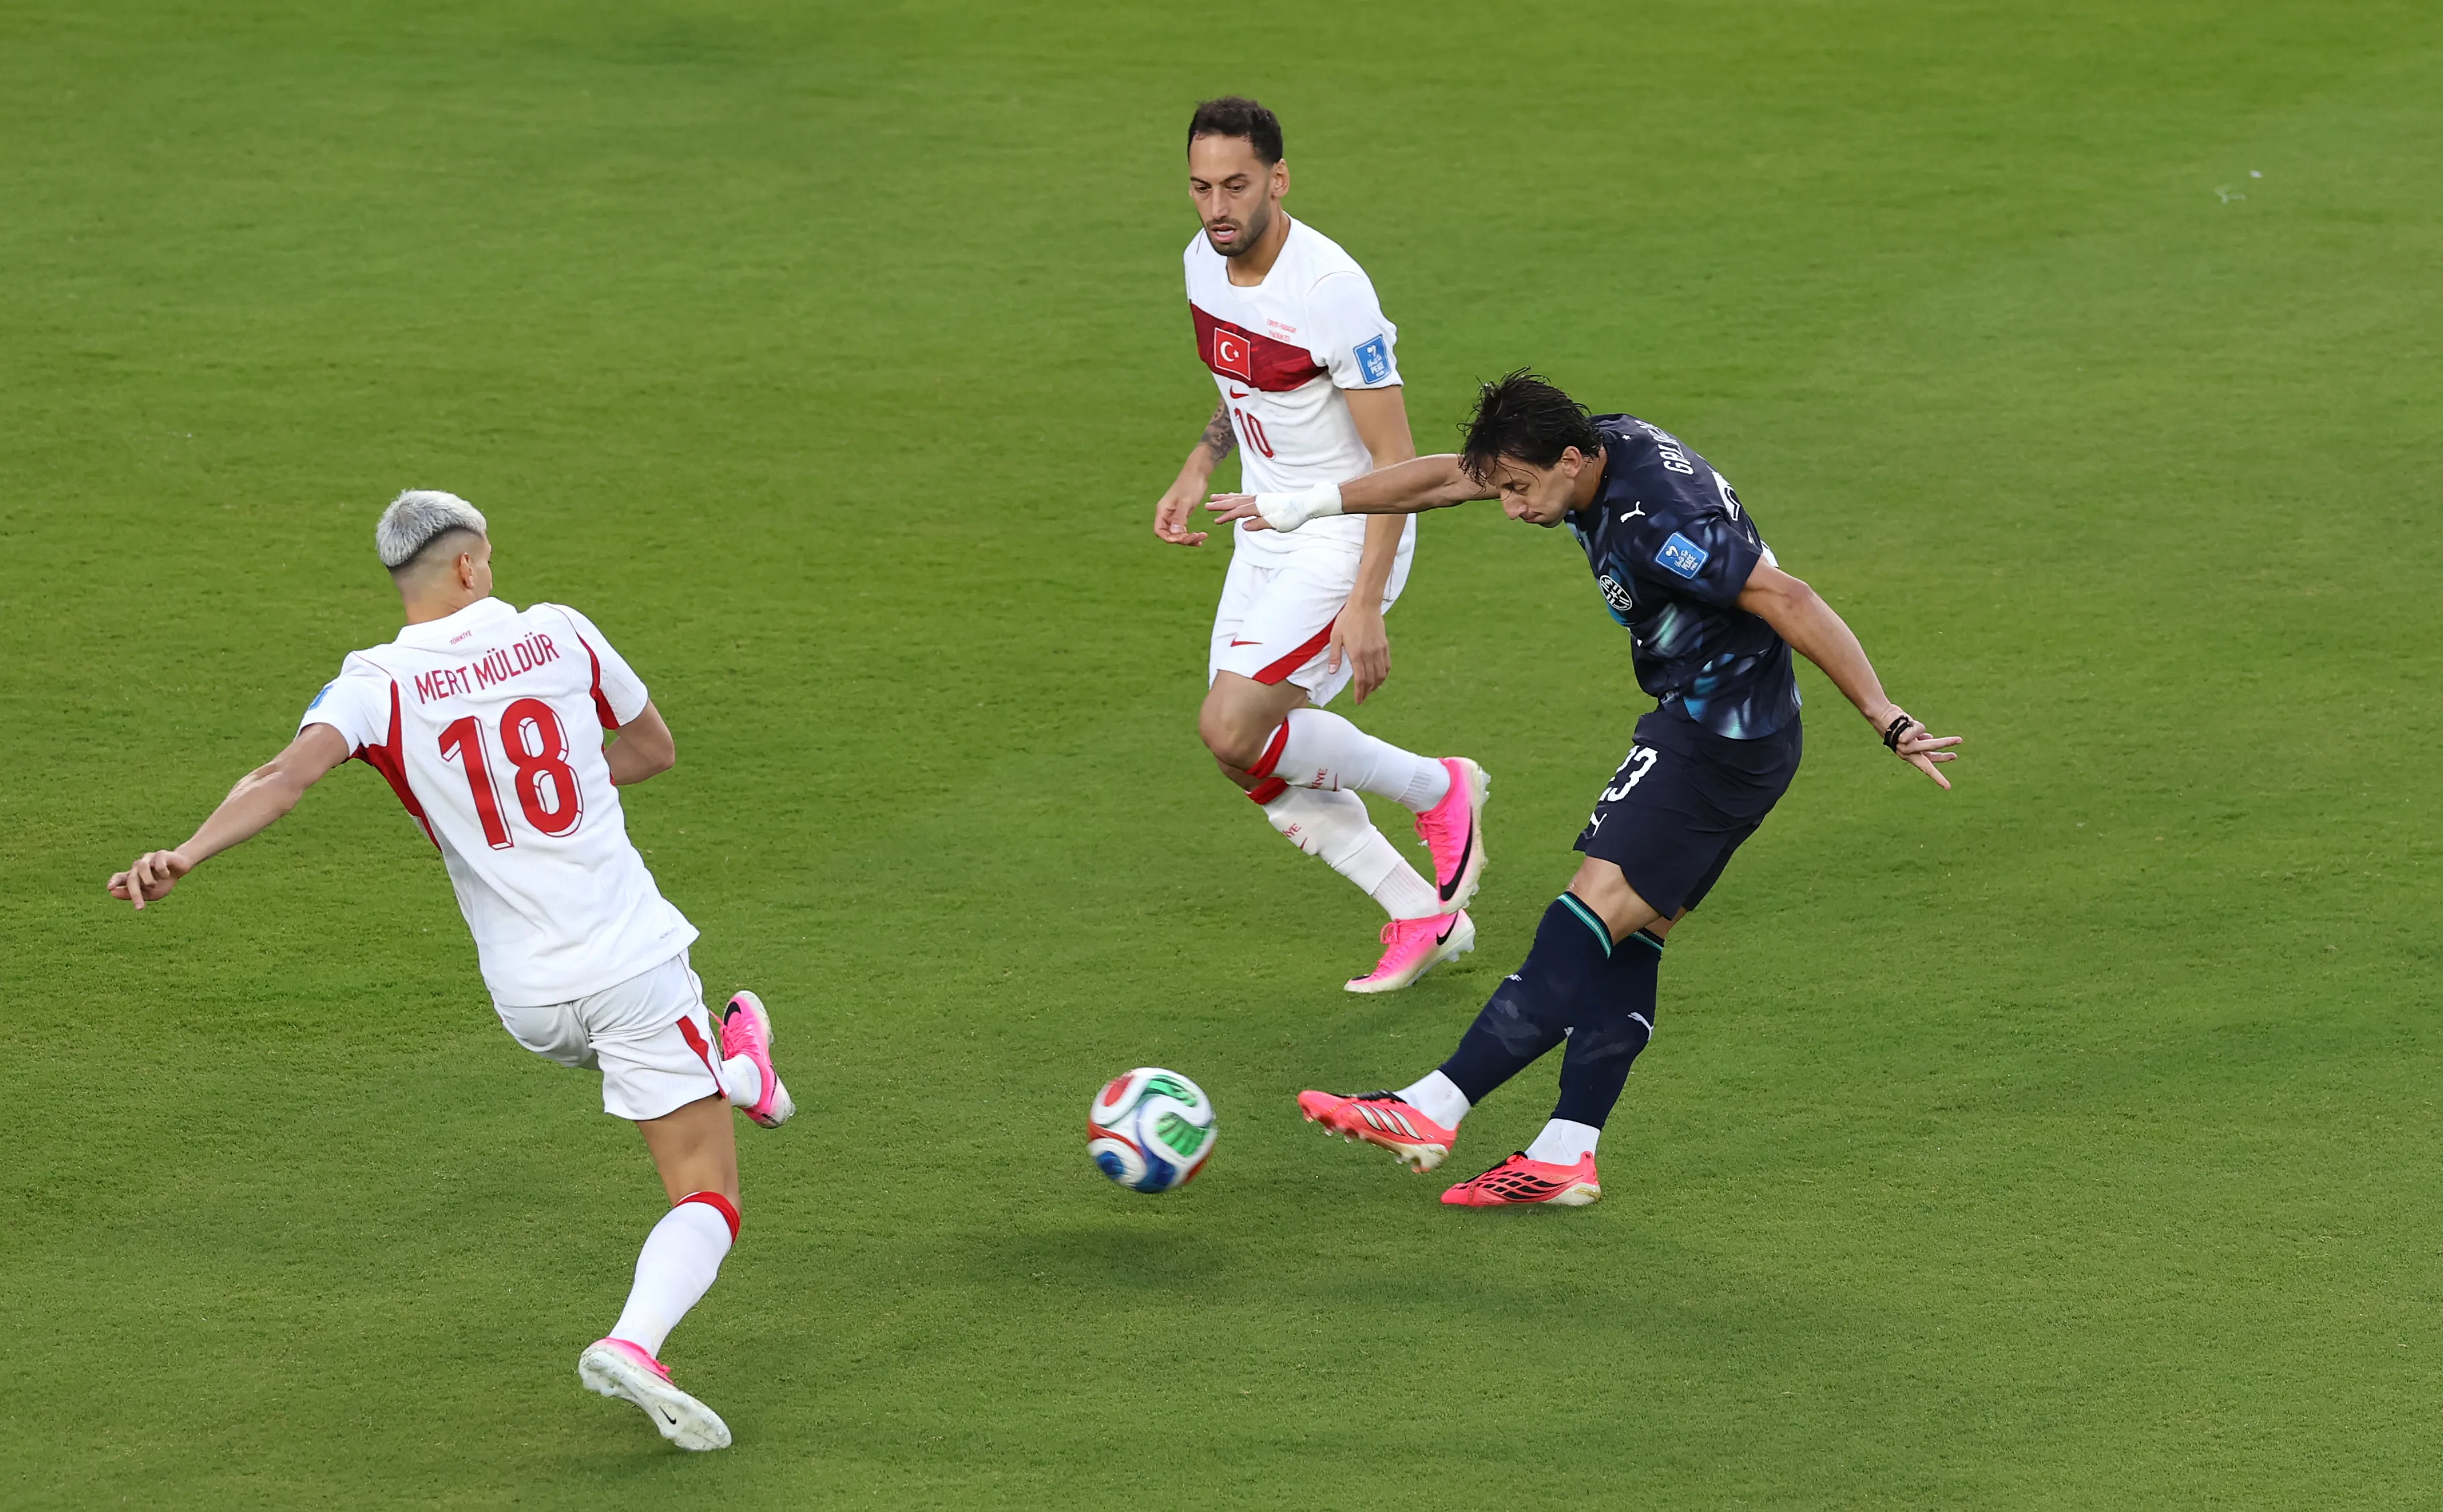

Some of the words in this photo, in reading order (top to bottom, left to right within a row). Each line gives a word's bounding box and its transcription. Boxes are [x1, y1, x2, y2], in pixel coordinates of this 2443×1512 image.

[1234, 407, 1276, 461] 10
[1681, 554, 1696, 571] PEACE
[449, 630, 473, 646] TÜRKİYE
[414, 666, 471, 705] MERT
[472, 632, 560, 690] MÜLDÜR
[438, 699, 584, 850] 18
